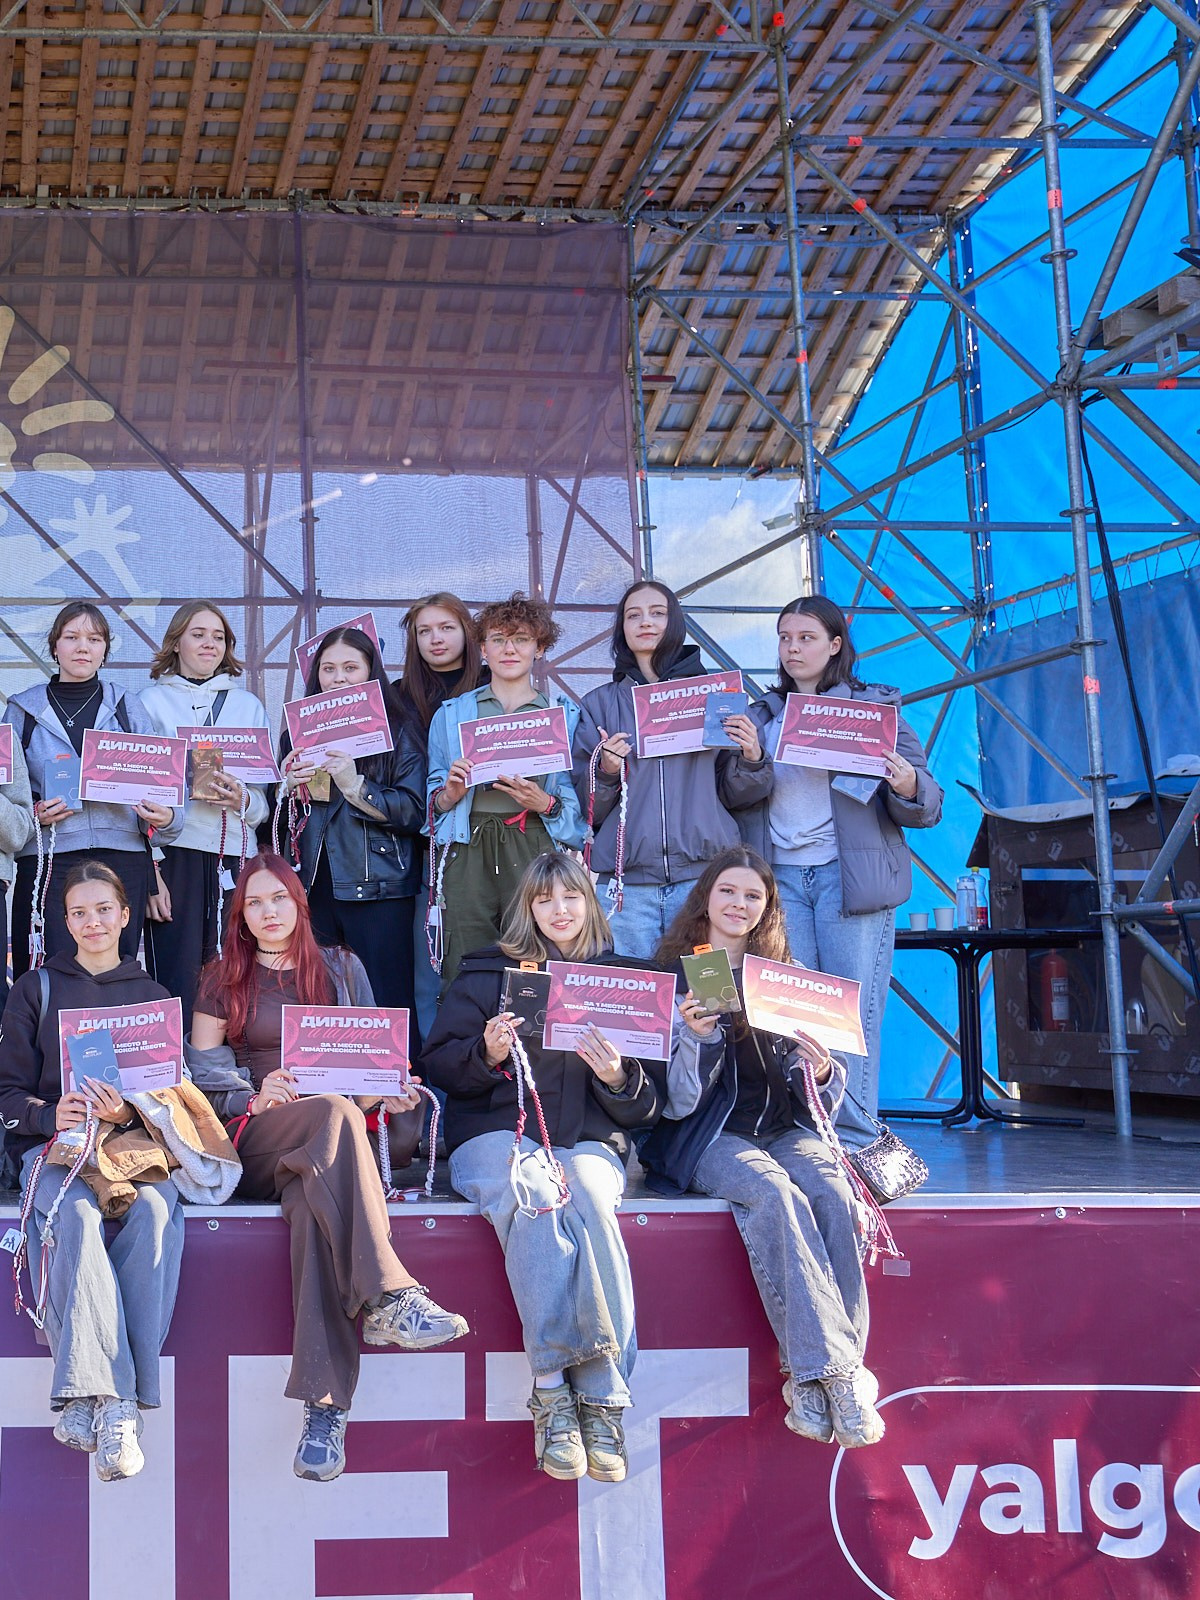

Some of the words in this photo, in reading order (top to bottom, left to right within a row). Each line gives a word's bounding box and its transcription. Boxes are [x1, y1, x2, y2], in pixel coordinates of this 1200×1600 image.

[649, 682, 727, 704] ДИПЛОМ
[299, 691, 368, 717] ДИПЛОМ
[652, 712, 703, 724] ТЕМАТИЧЕСКОМ
[802, 704, 882, 722] ДИПЛОМ
[475, 718, 551, 735] ДИПЛОМ
[191, 734, 256, 743] ДИПЛОМ
[798, 730, 853, 741] ТЕМАТИЧЕСКОМ
[98, 740, 172, 756] ДИПЛОМ
[96, 765, 146, 773] ТЕМАТИЧЕСКОМ
[565, 973, 656, 994] ДИПЛОМ
[760, 969, 843, 998] ДИПЛОМ
[564, 1004, 624, 1015] ТЕМАТИЧЕСКОМ
[625, 1010, 654, 1018] КВЕСТЕ
[78, 1012, 165, 1033] ДИПЛОМ
[301, 1016, 390, 1030] ДИПЛОМ
[140, 1043, 166, 1051] КВЕСТЕ
